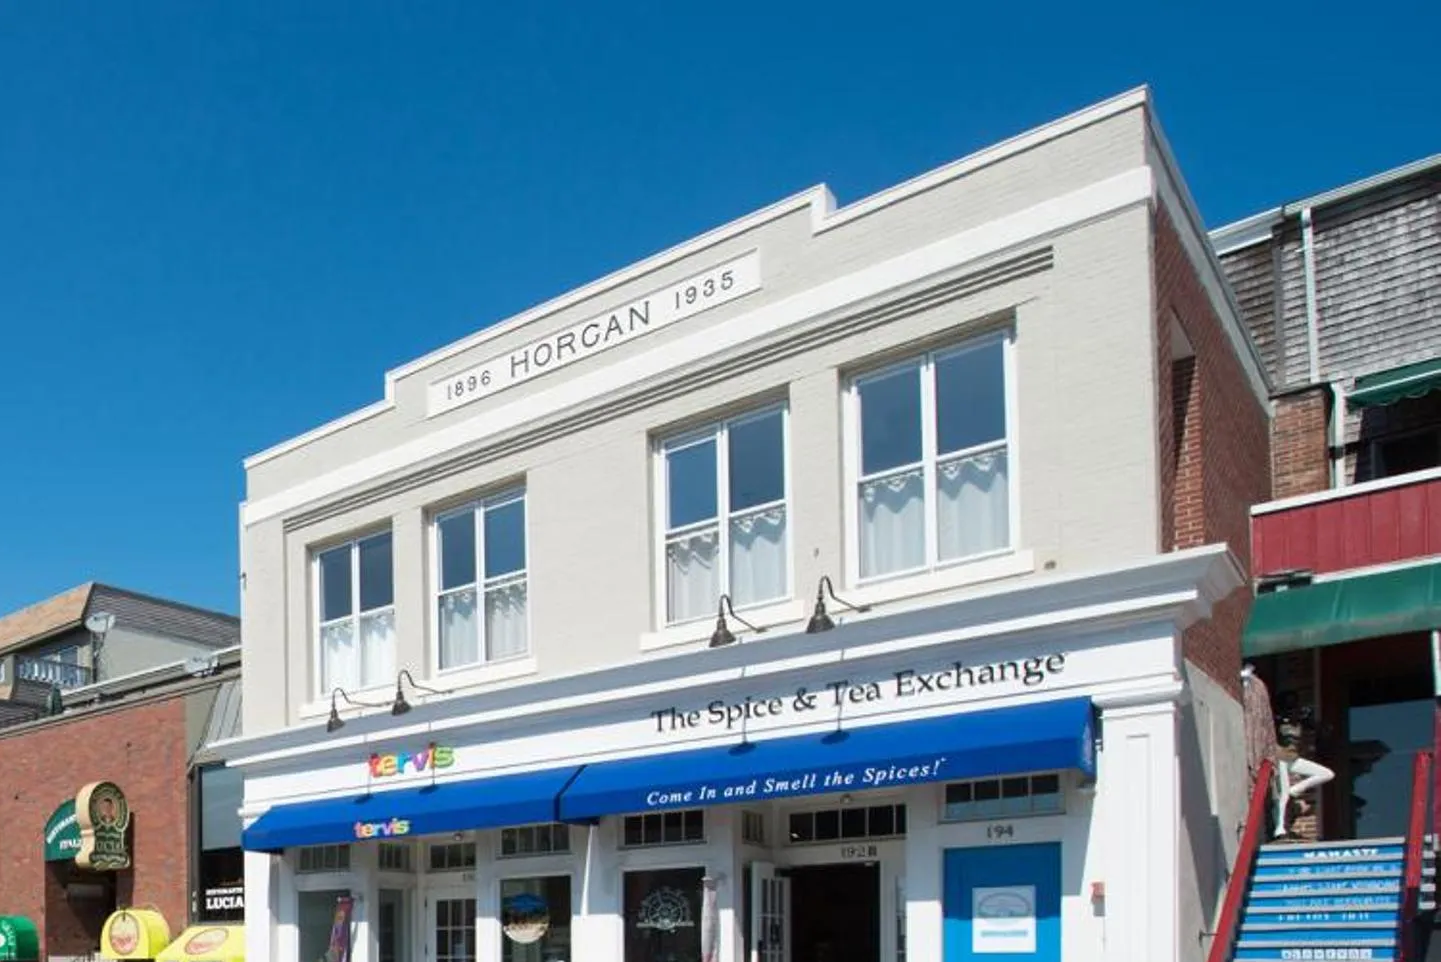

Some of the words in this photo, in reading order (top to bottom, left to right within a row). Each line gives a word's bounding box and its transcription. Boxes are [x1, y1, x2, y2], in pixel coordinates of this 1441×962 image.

[447, 369, 492, 400] 1896
[510, 300, 651, 378] HORGAN
[675, 270, 734, 309] 1935
[650, 706, 701, 733] The
[707, 695, 784, 730] Spice
[792, 686, 818, 713] &
[825, 679, 883, 706] Tea
[892, 651, 1067, 698] Exchange
[367, 743, 457, 779] tervis
[646, 790, 693, 806] Come
[698, 785, 717, 801] In
[723, 779, 757, 798] and
[763, 771, 818, 794] Smell
[823, 770, 855, 787] the
[861, 759, 942, 786] Spices!
[352, 817, 411, 839] tervis
[986, 824, 1014, 839] 194
[205, 895, 245, 911] LUCIA
